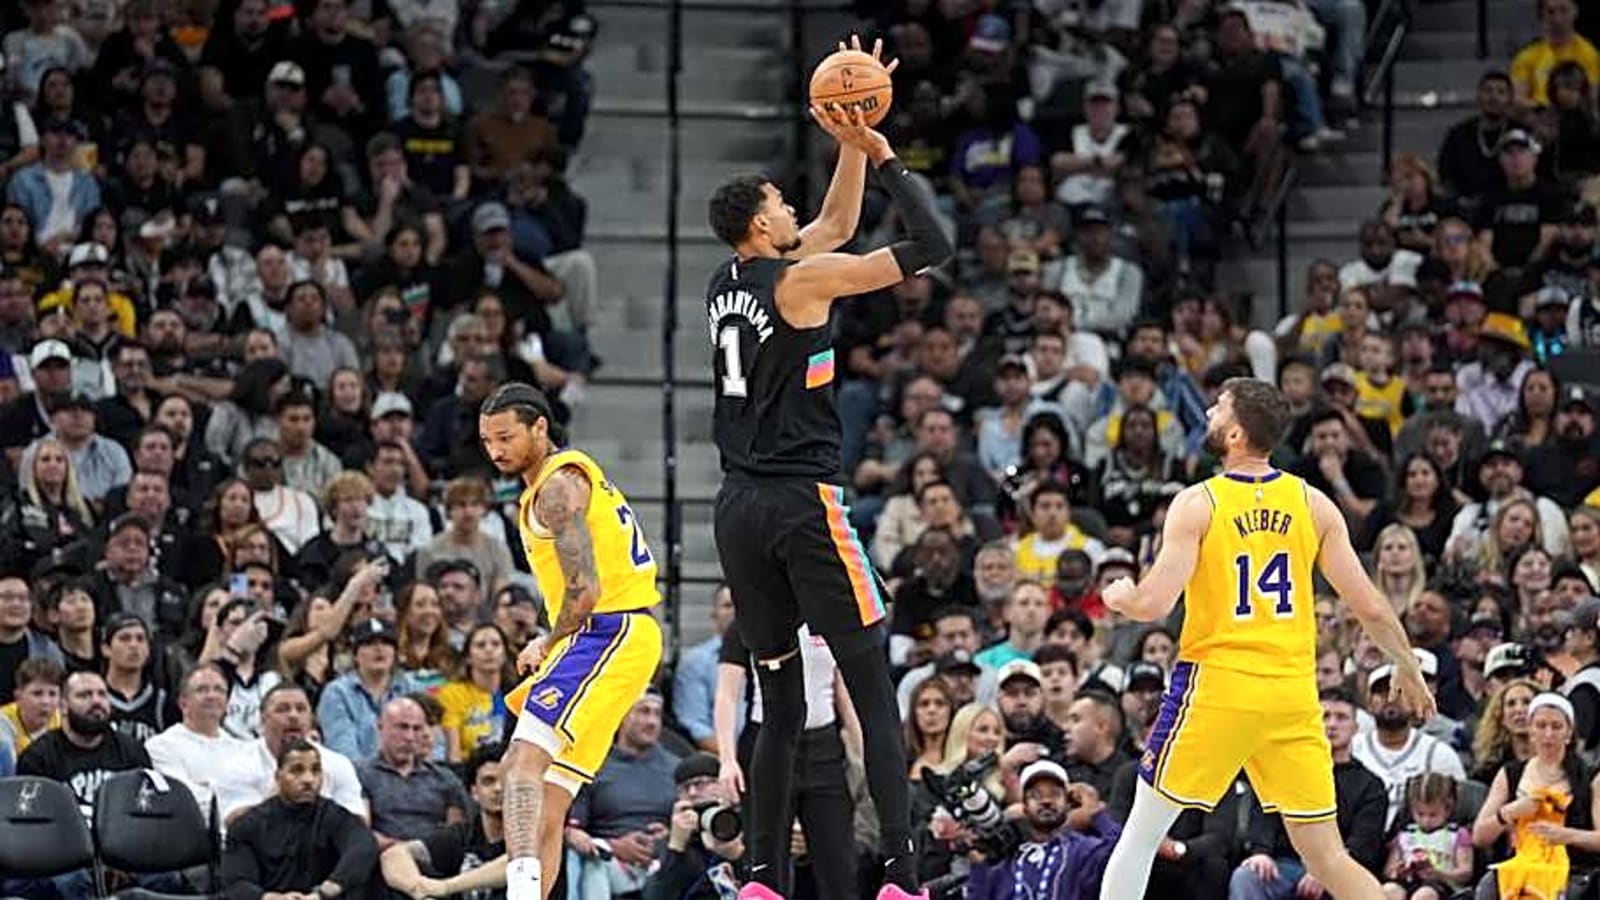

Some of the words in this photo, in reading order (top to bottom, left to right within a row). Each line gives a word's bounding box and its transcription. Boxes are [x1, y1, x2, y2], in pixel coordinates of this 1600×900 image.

[719, 325, 747, 397] 1
[1233, 508, 1292, 538] KLEBER
[1235, 552, 1293, 616] 14
